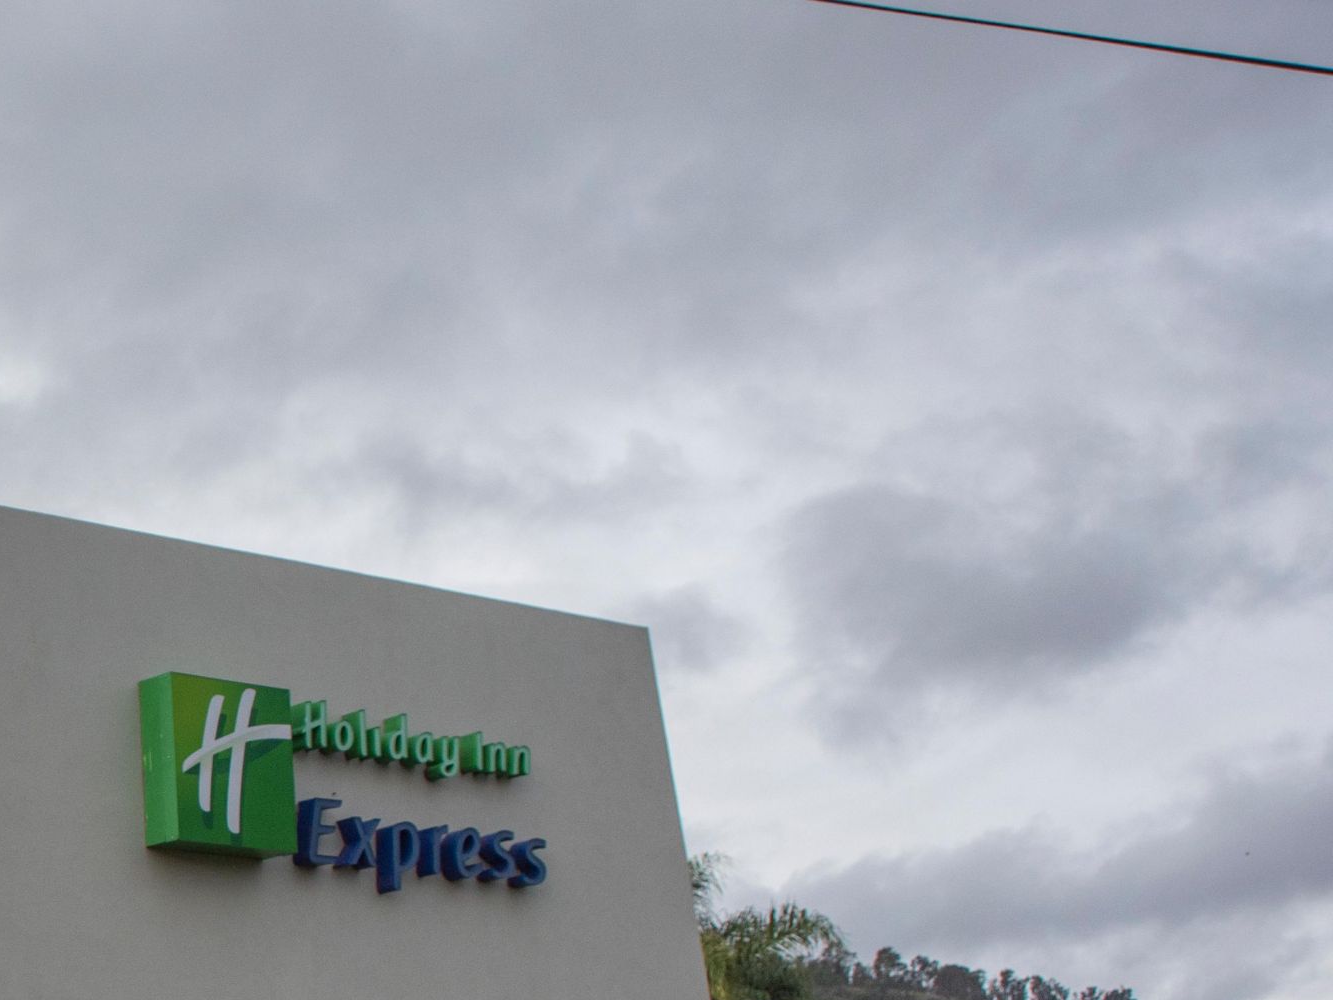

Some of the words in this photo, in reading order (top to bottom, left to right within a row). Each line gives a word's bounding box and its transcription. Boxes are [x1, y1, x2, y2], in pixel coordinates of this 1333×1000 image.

[291, 700, 461, 780] Holiday
[462, 731, 531, 777] Inn
[294, 797, 547, 894] Express
